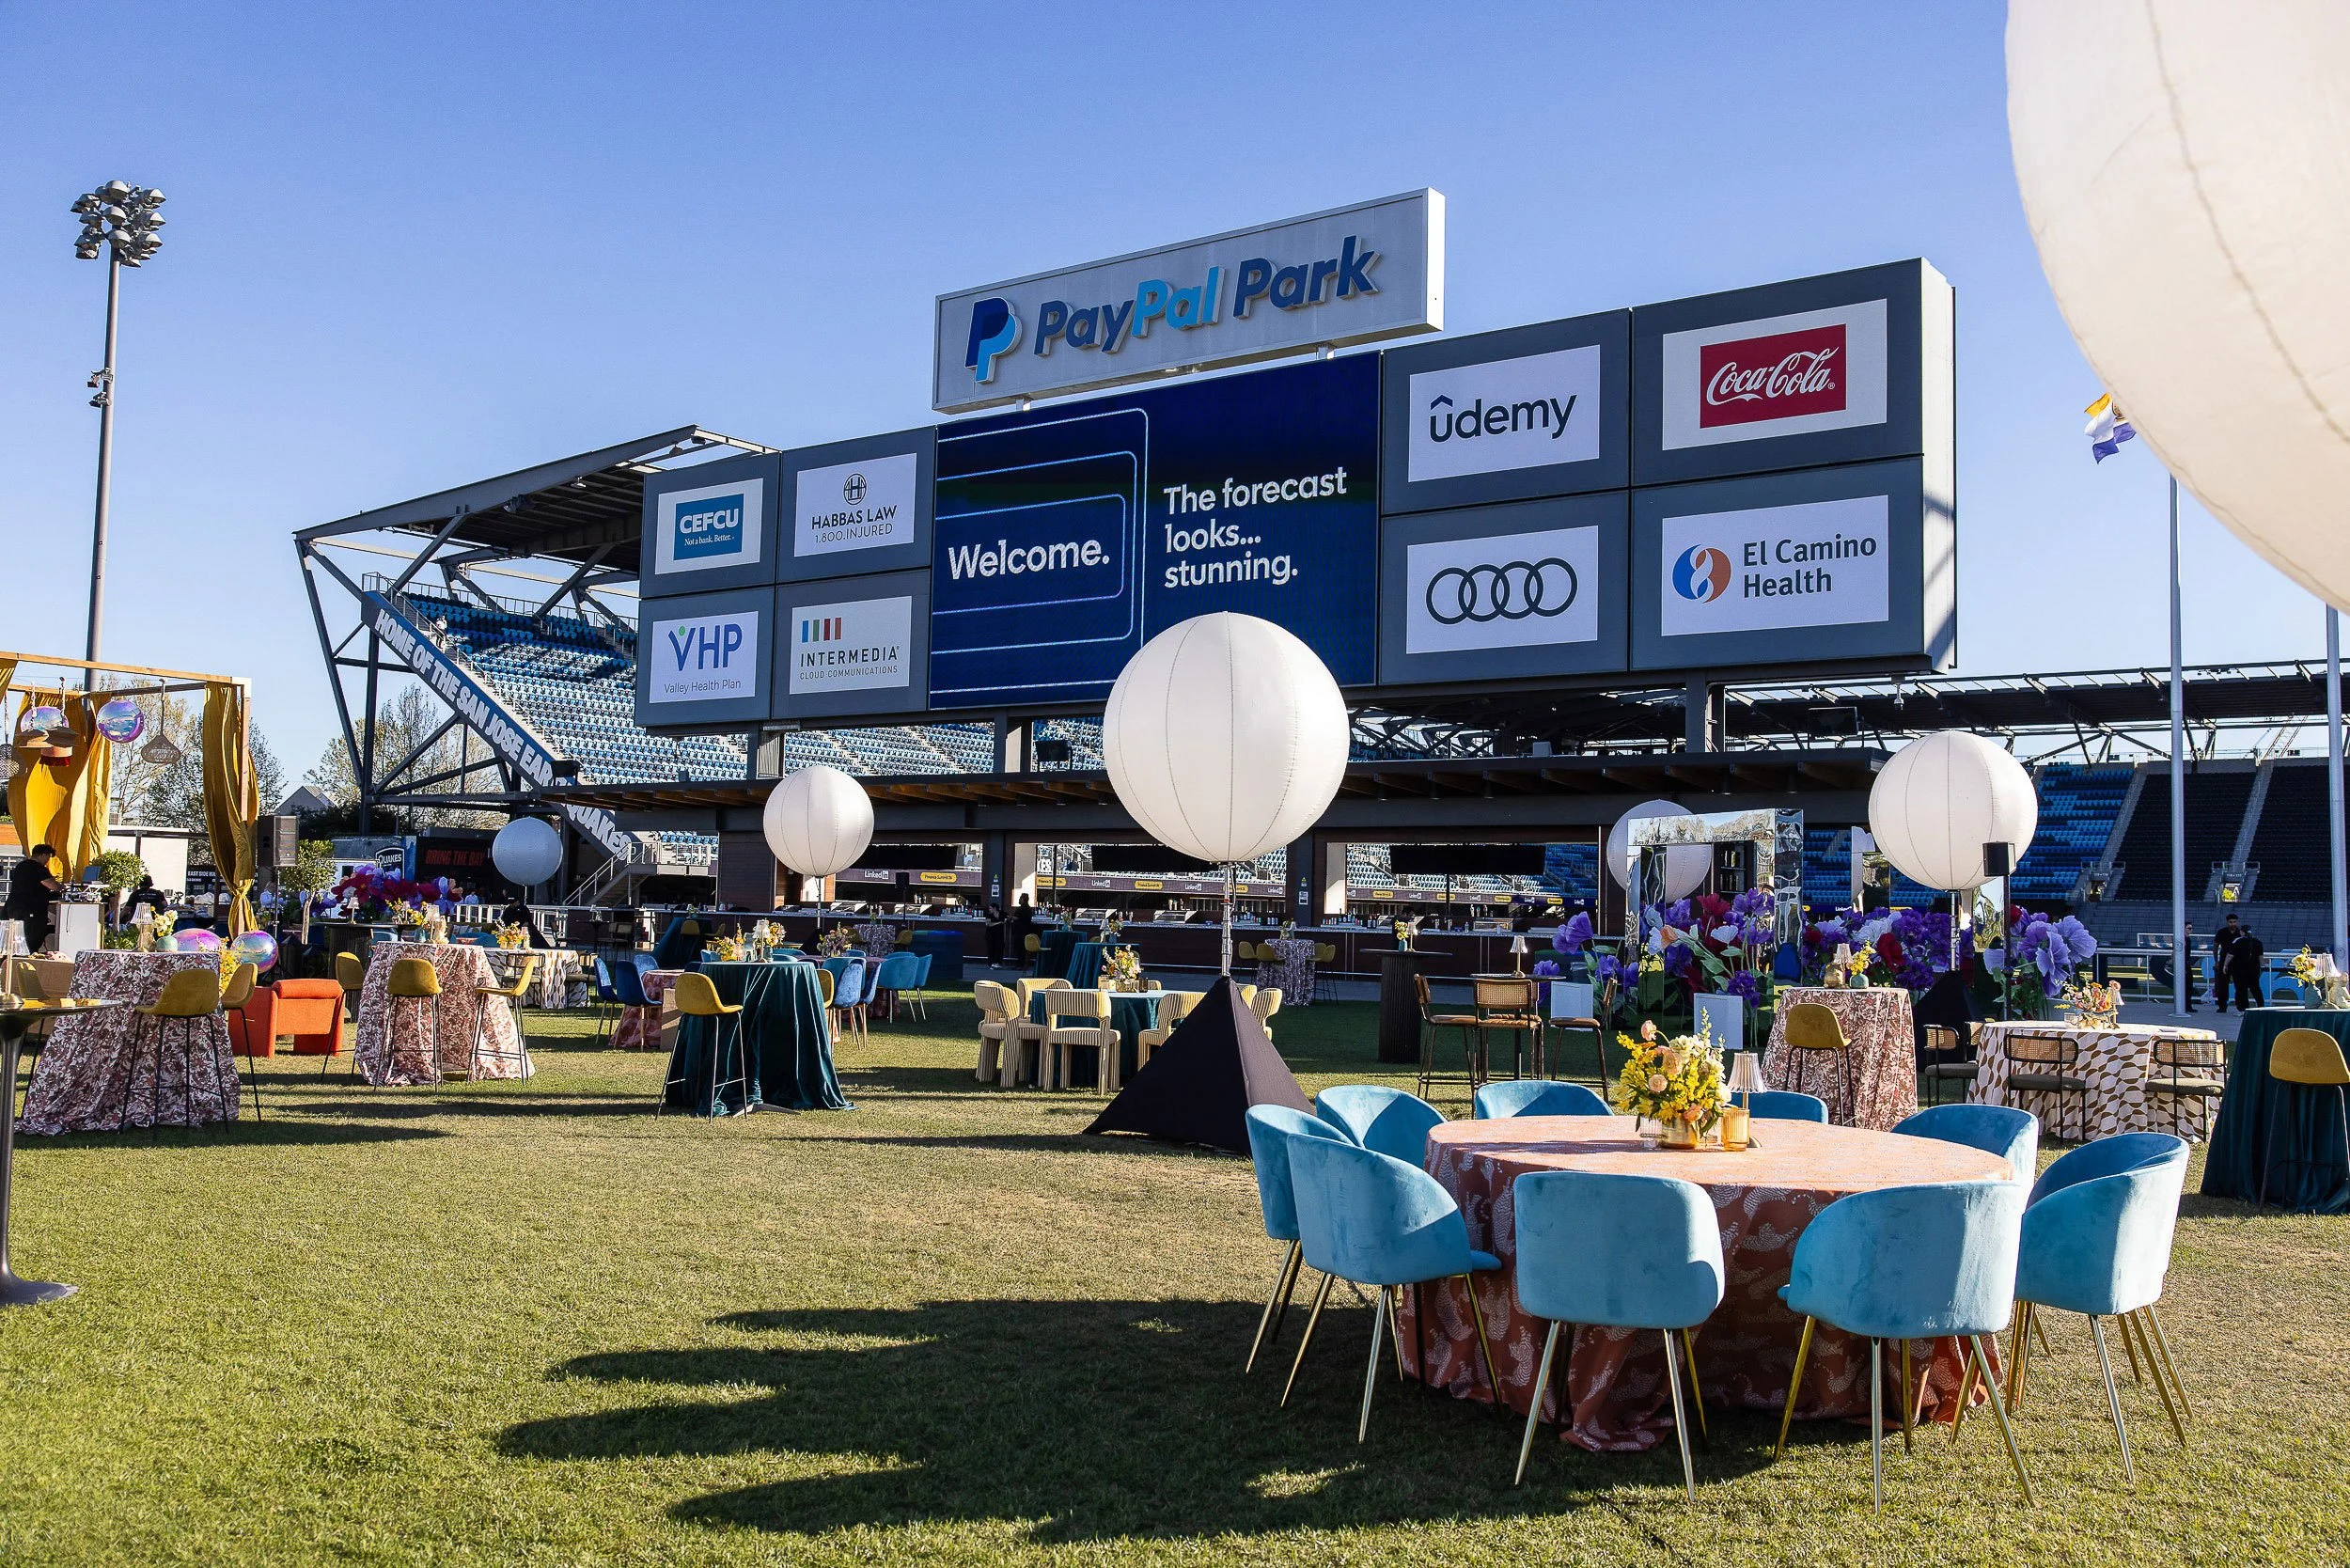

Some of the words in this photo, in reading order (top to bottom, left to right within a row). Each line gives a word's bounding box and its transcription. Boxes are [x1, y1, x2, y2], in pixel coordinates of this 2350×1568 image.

[1034, 266, 1225, 357] PayPal
[1232, 235, 1382, 320] Park
[1706, 345, 1840, 406] Coca-Cola
[1164, 484, 1215, 515] The
[1222, 466, 1348, 508] forecast
[680, 508, 739, 534] CEFCU
[811, 509, 863, 530] HABBAS
[867, 505, 898, 523] LAW
[684, 538, 694, 546] Not
[815, 524, 893, 543] 1.800.INJURED
[1165, 519, 1261, 553] looks...
[948, 539, 1110, 580] Welcome.
[1743, 541, 1769, 567] El
[1775, 533, 1877, 564] Camino
[1165, 550, 1299, 588] stunning.
[1744, 568, 1833, 599] Health
[668, 623, 743, 671] VHP
[800, 646, 898, 667] INTERMEDIA
[375, 608, 416, 660] HOME
[413, 645, 434, 674] OF
[431, 660, 461, 702] THE
[456, 686, 490, 729] SAN
[485, 713, 525, 761] JOSE
[665, 682, 689, 695] Valley
[691, 679, 719, 692] Health
[722, 679, 742, 690] Plan
[800, 668, 825, 680] CLOUD
[827, 665, 898, 678] COMMUNICATIONS
[378, 854, 402, 865] QUAKES
[425, 849, 451, 865] BRING
[453, 851, 468, 866] THE
[468, 851, 485, 867] BAY
